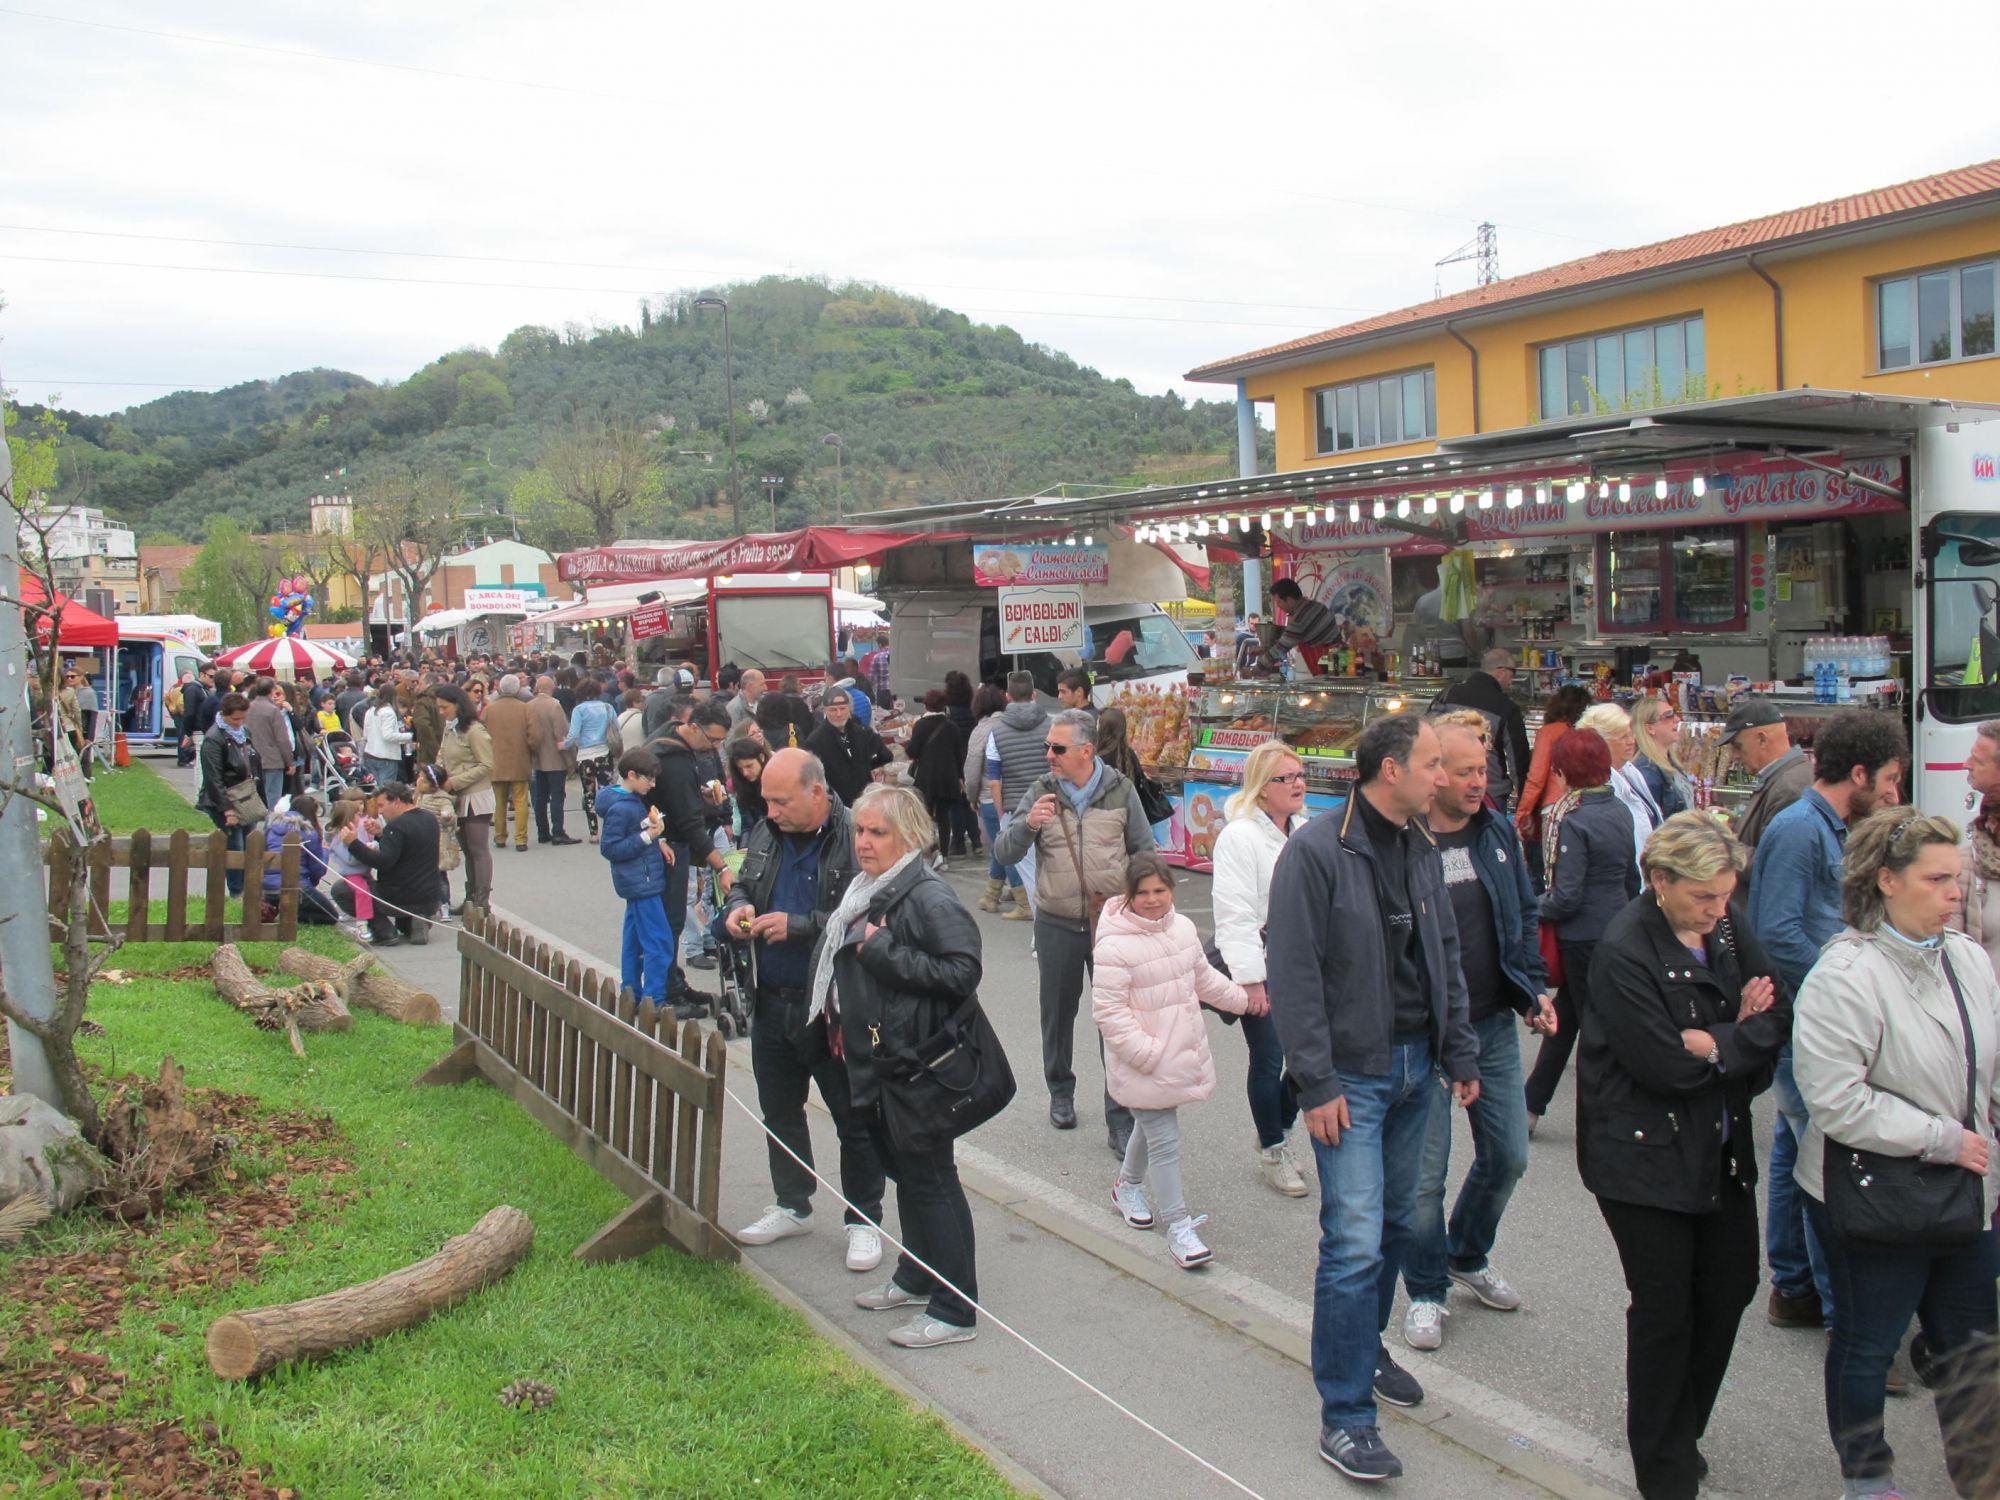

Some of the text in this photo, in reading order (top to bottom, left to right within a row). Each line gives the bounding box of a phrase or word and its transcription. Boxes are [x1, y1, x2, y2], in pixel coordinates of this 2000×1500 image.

[1724, 472, 1816, 514] Gelato
[738, 542, 764, 564] Frutta
[766, 543, 795, 562] secca
[1005, 602, 1079, 621] BOMBOLONI
[1024, 625, 1061, 643] CALDI
